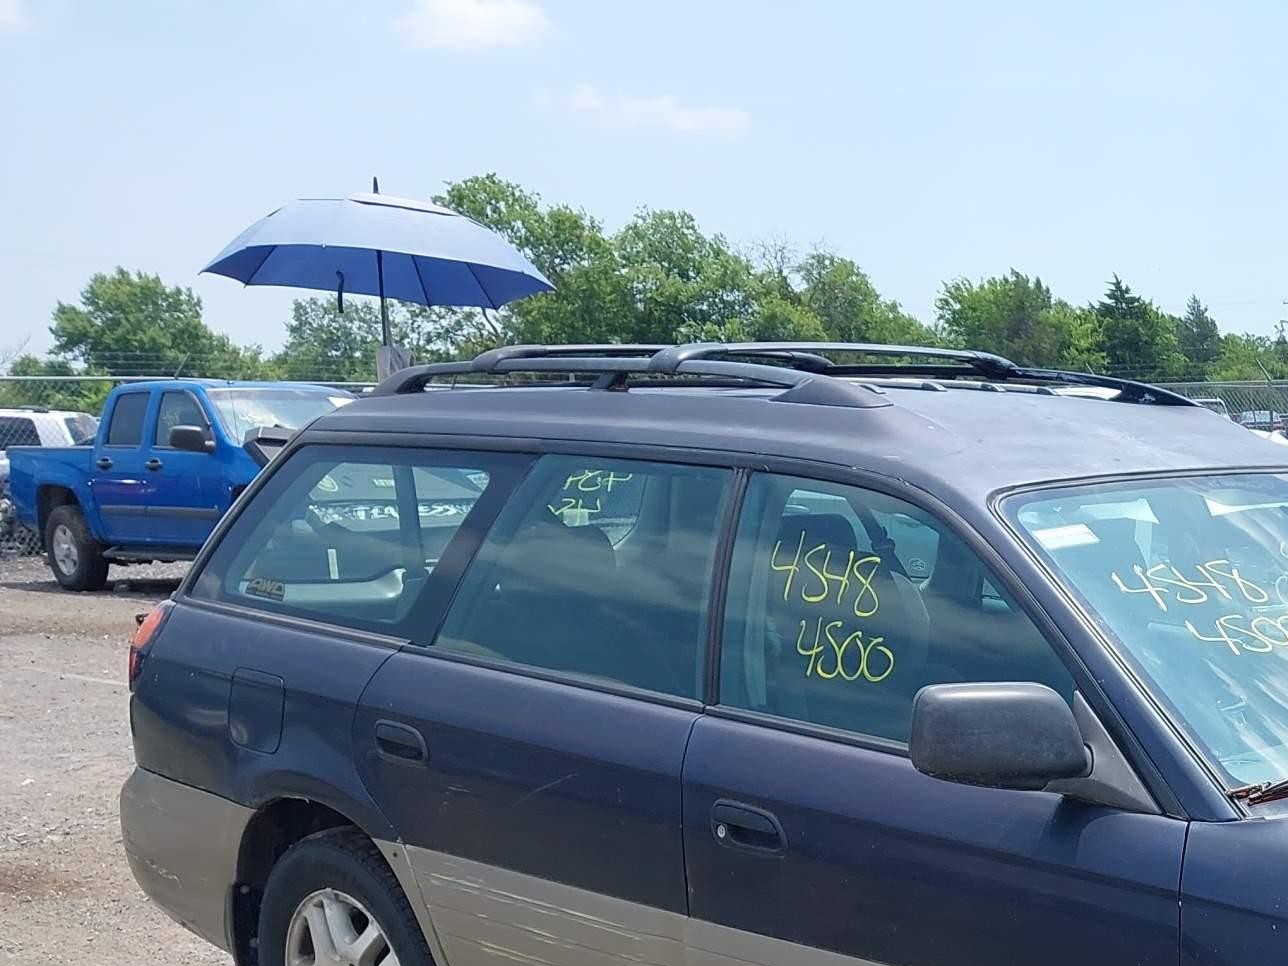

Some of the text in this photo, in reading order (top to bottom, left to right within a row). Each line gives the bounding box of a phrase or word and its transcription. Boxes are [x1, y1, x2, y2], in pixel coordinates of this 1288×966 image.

[770, 529, 881, 618] 4548
[1110, 559, 1270, 613] 4548
[796, 616, 895, 682] 4500
